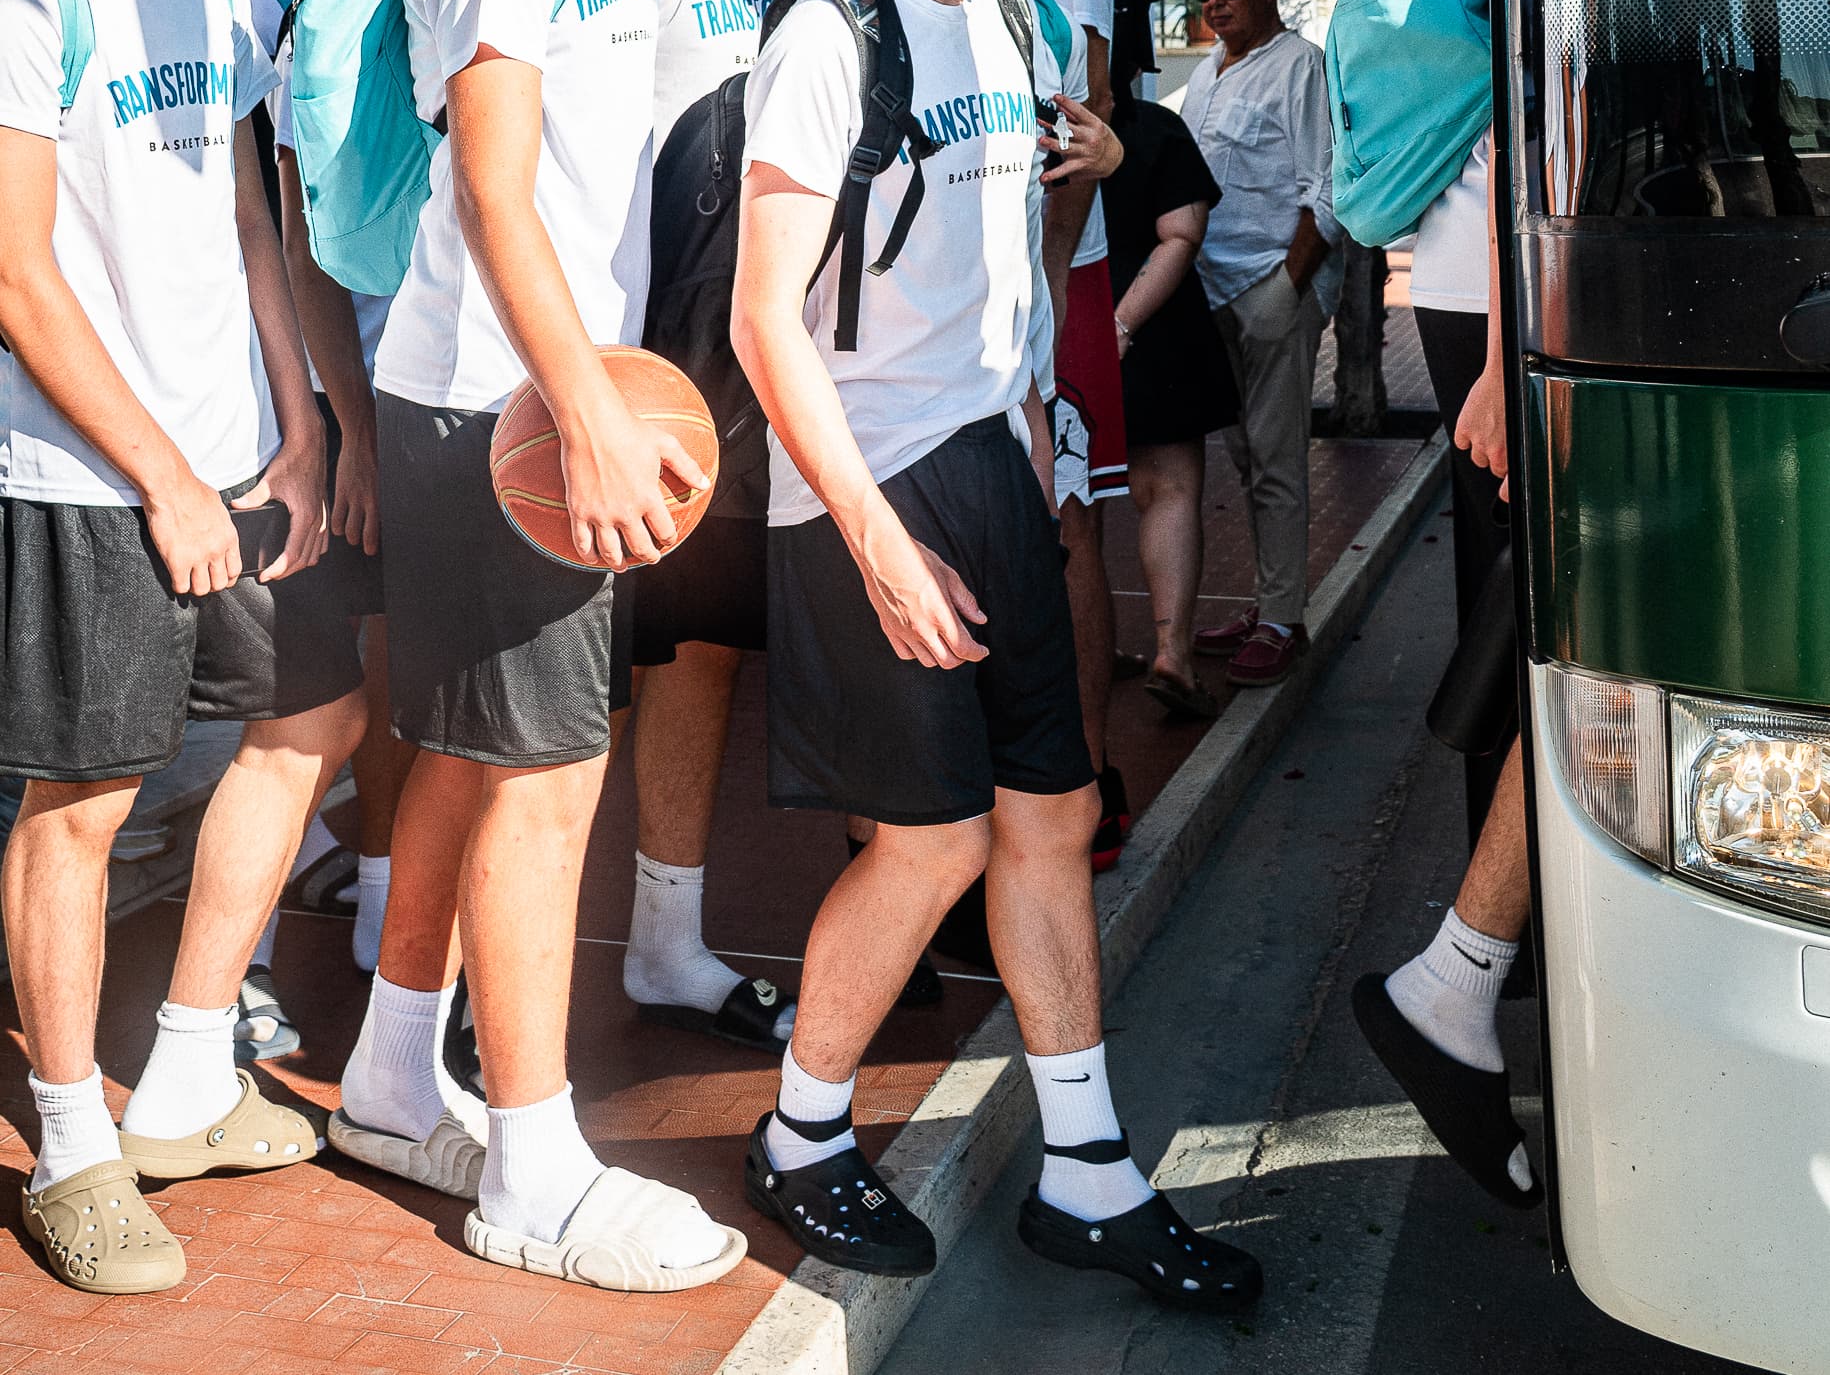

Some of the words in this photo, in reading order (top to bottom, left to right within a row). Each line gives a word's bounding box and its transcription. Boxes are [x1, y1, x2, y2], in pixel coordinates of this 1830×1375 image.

[611, 29, 650, 44] BASKET
[149, 134, 227, 152] BASKETBAL
[948, 161, 1024, 184] BASKETBALL
